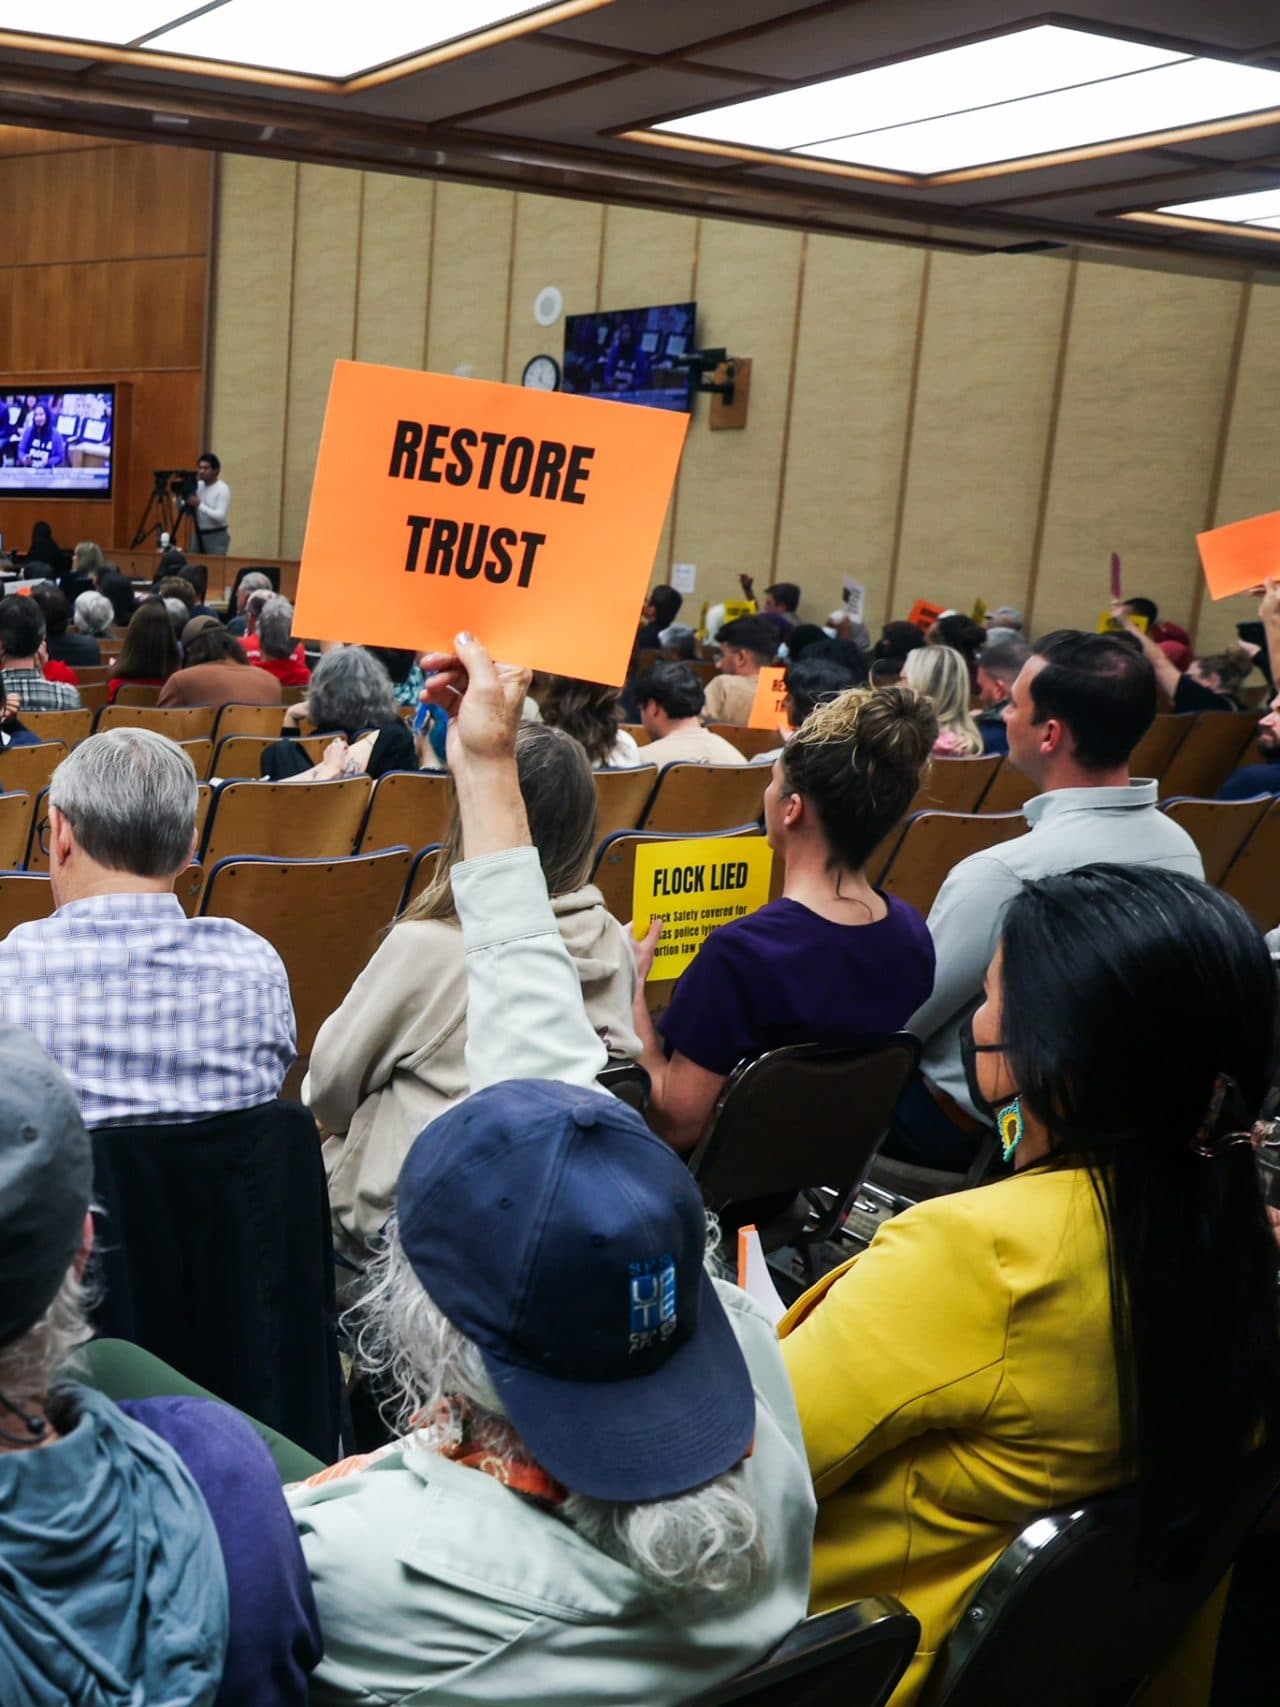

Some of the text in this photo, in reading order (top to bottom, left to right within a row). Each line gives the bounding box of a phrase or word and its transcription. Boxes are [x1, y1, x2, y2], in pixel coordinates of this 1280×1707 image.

[388, 420, 595, 505] RESTORE
[405, 515, 546, 588] TRUST
[653, 861, 749, 897] FLOCK LIED
[673, 910, 698, 922] Safety
[675, 926, 699, 939] police
[655, 945, 678, 957] ortion
